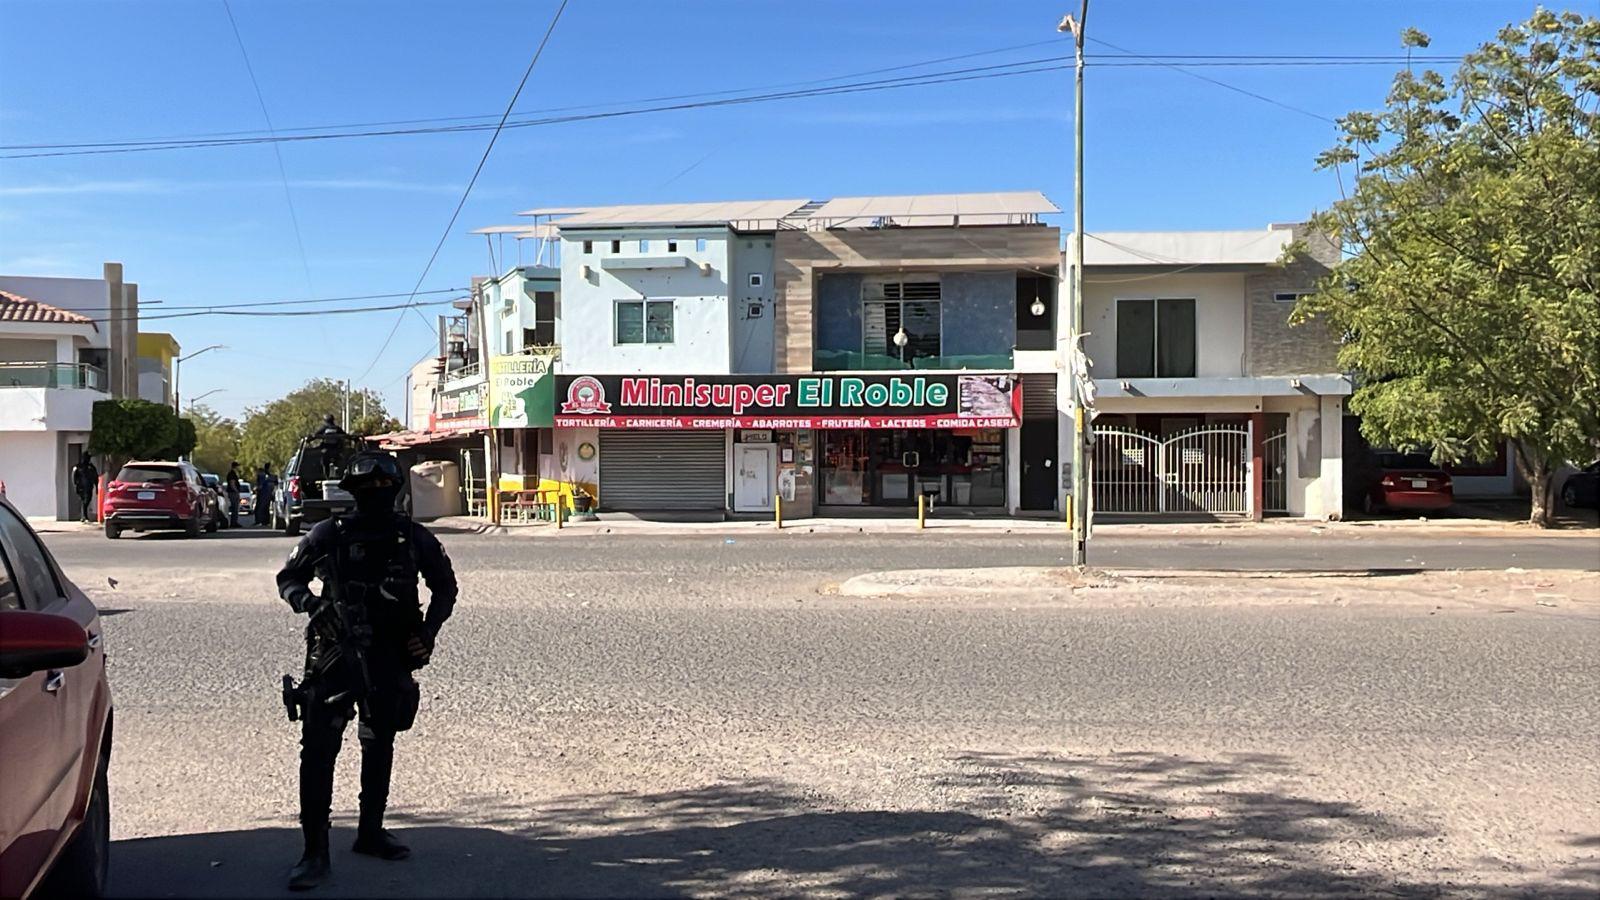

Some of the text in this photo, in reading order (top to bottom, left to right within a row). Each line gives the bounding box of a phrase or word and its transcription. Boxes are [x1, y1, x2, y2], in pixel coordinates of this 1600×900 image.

[621, 378, 948, 414] Minisuper El Roble
[556, 417, 616, 428] TORTILLERÍA
[977, 418, 1018, 428] CASERA
